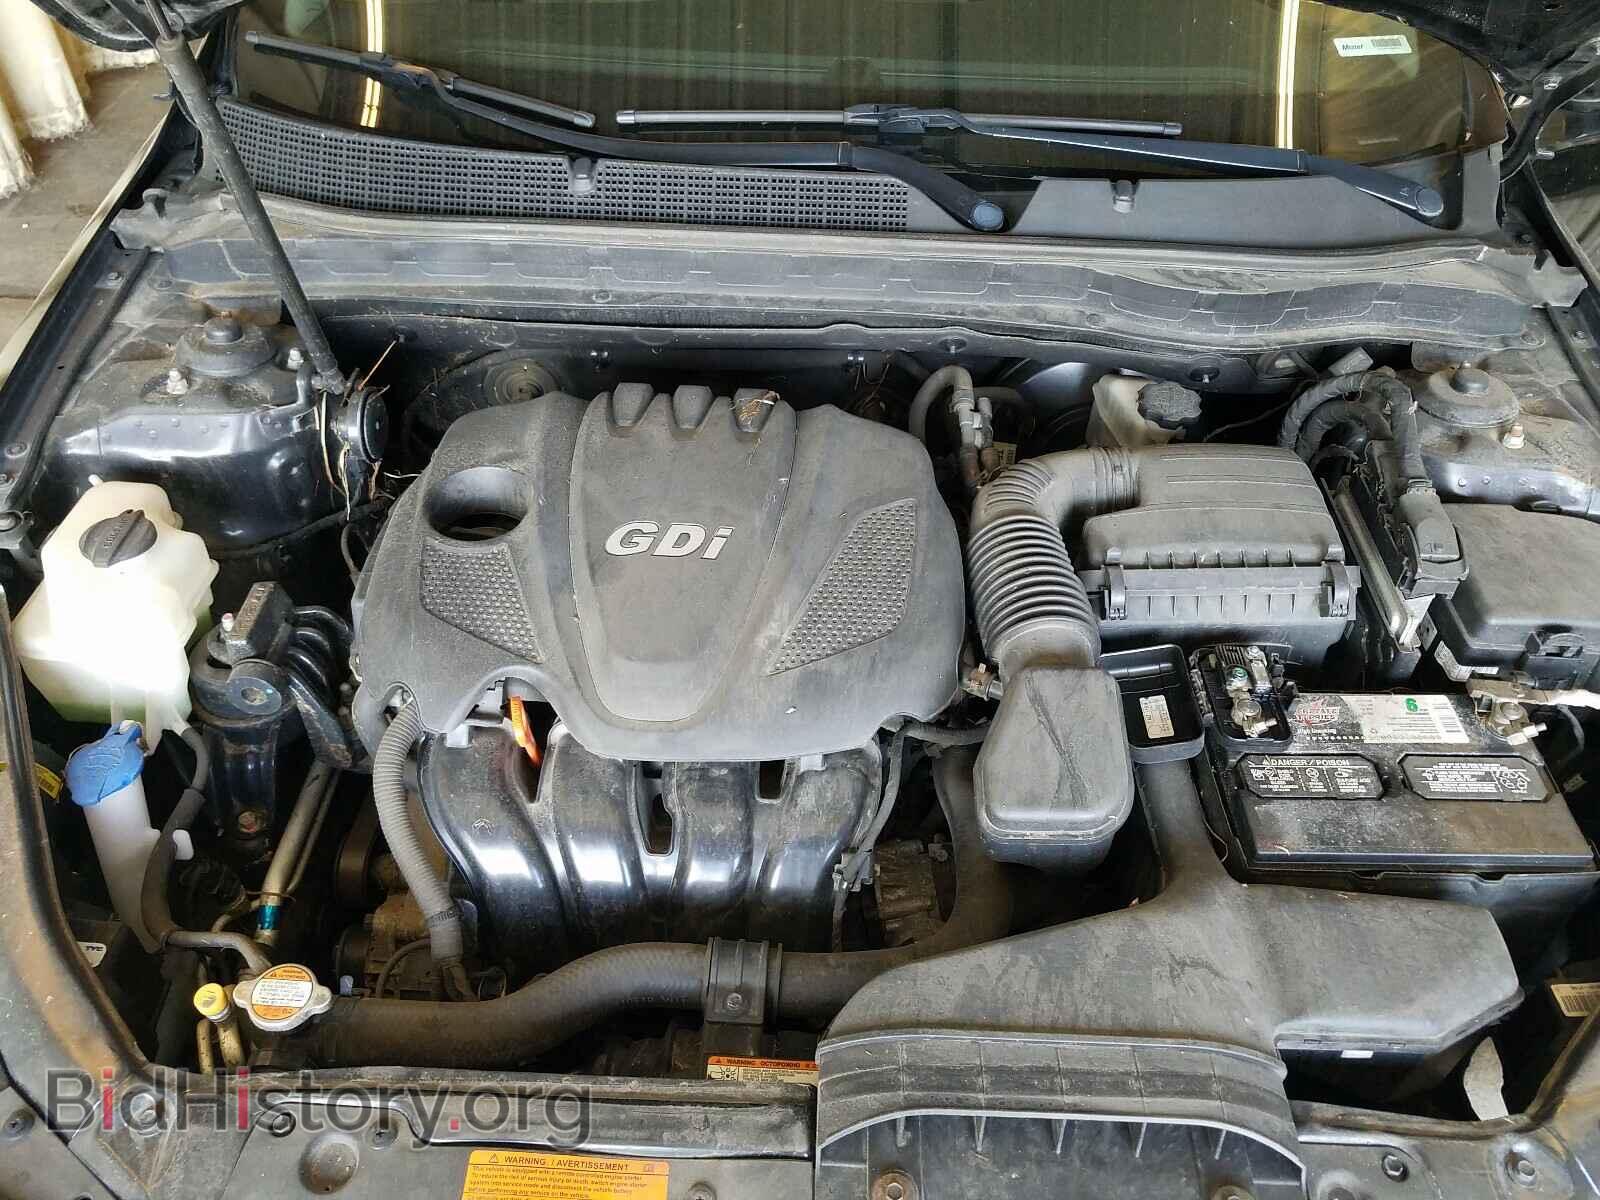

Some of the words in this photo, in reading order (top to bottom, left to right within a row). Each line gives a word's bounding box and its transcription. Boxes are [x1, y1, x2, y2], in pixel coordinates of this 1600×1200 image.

[605, 520, 734, 560] GDi
[1405, 697, 1420, 713] 6
[504, 1156, 546, 1166] WARNING
[556, 1159, 629, 1171] AVERTISSEMENT
